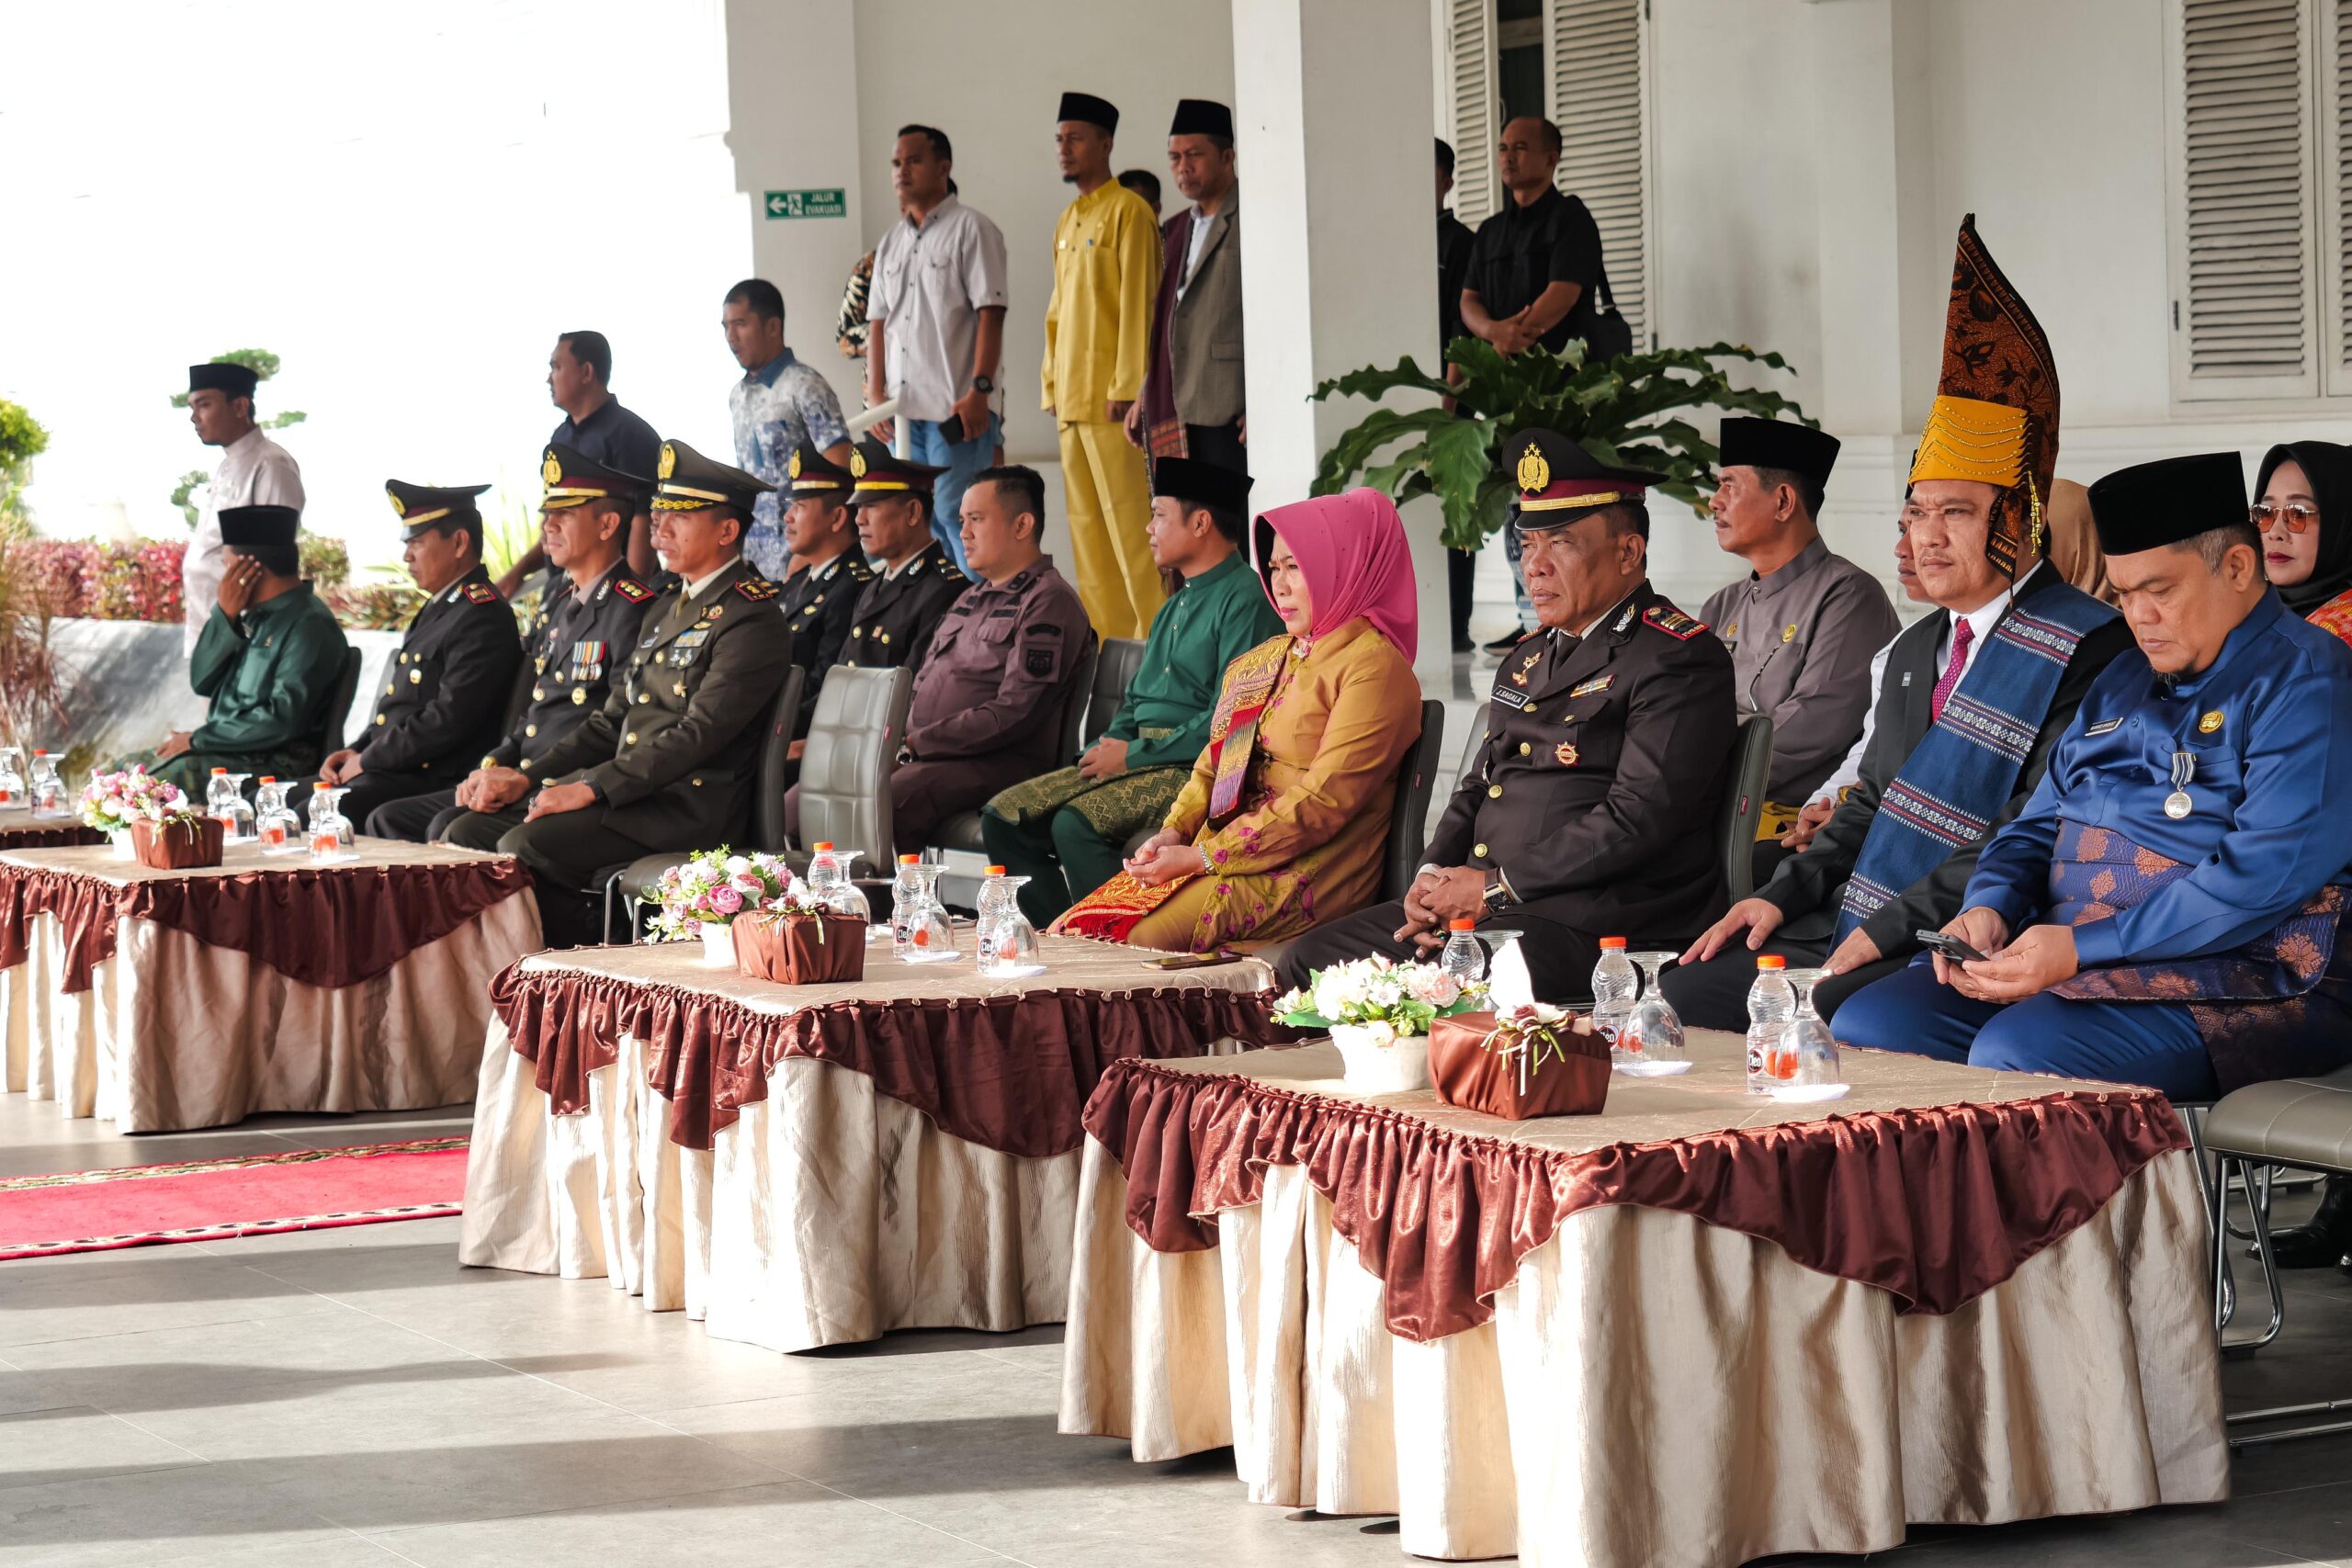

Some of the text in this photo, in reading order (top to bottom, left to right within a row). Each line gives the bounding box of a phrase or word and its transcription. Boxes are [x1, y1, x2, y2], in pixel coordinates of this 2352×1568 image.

[811, 193, 835, 203] JALUR
[805, 204, 842, 215] EVAKUASI
[1496, 689, 1522, 704] J.SAGALA
